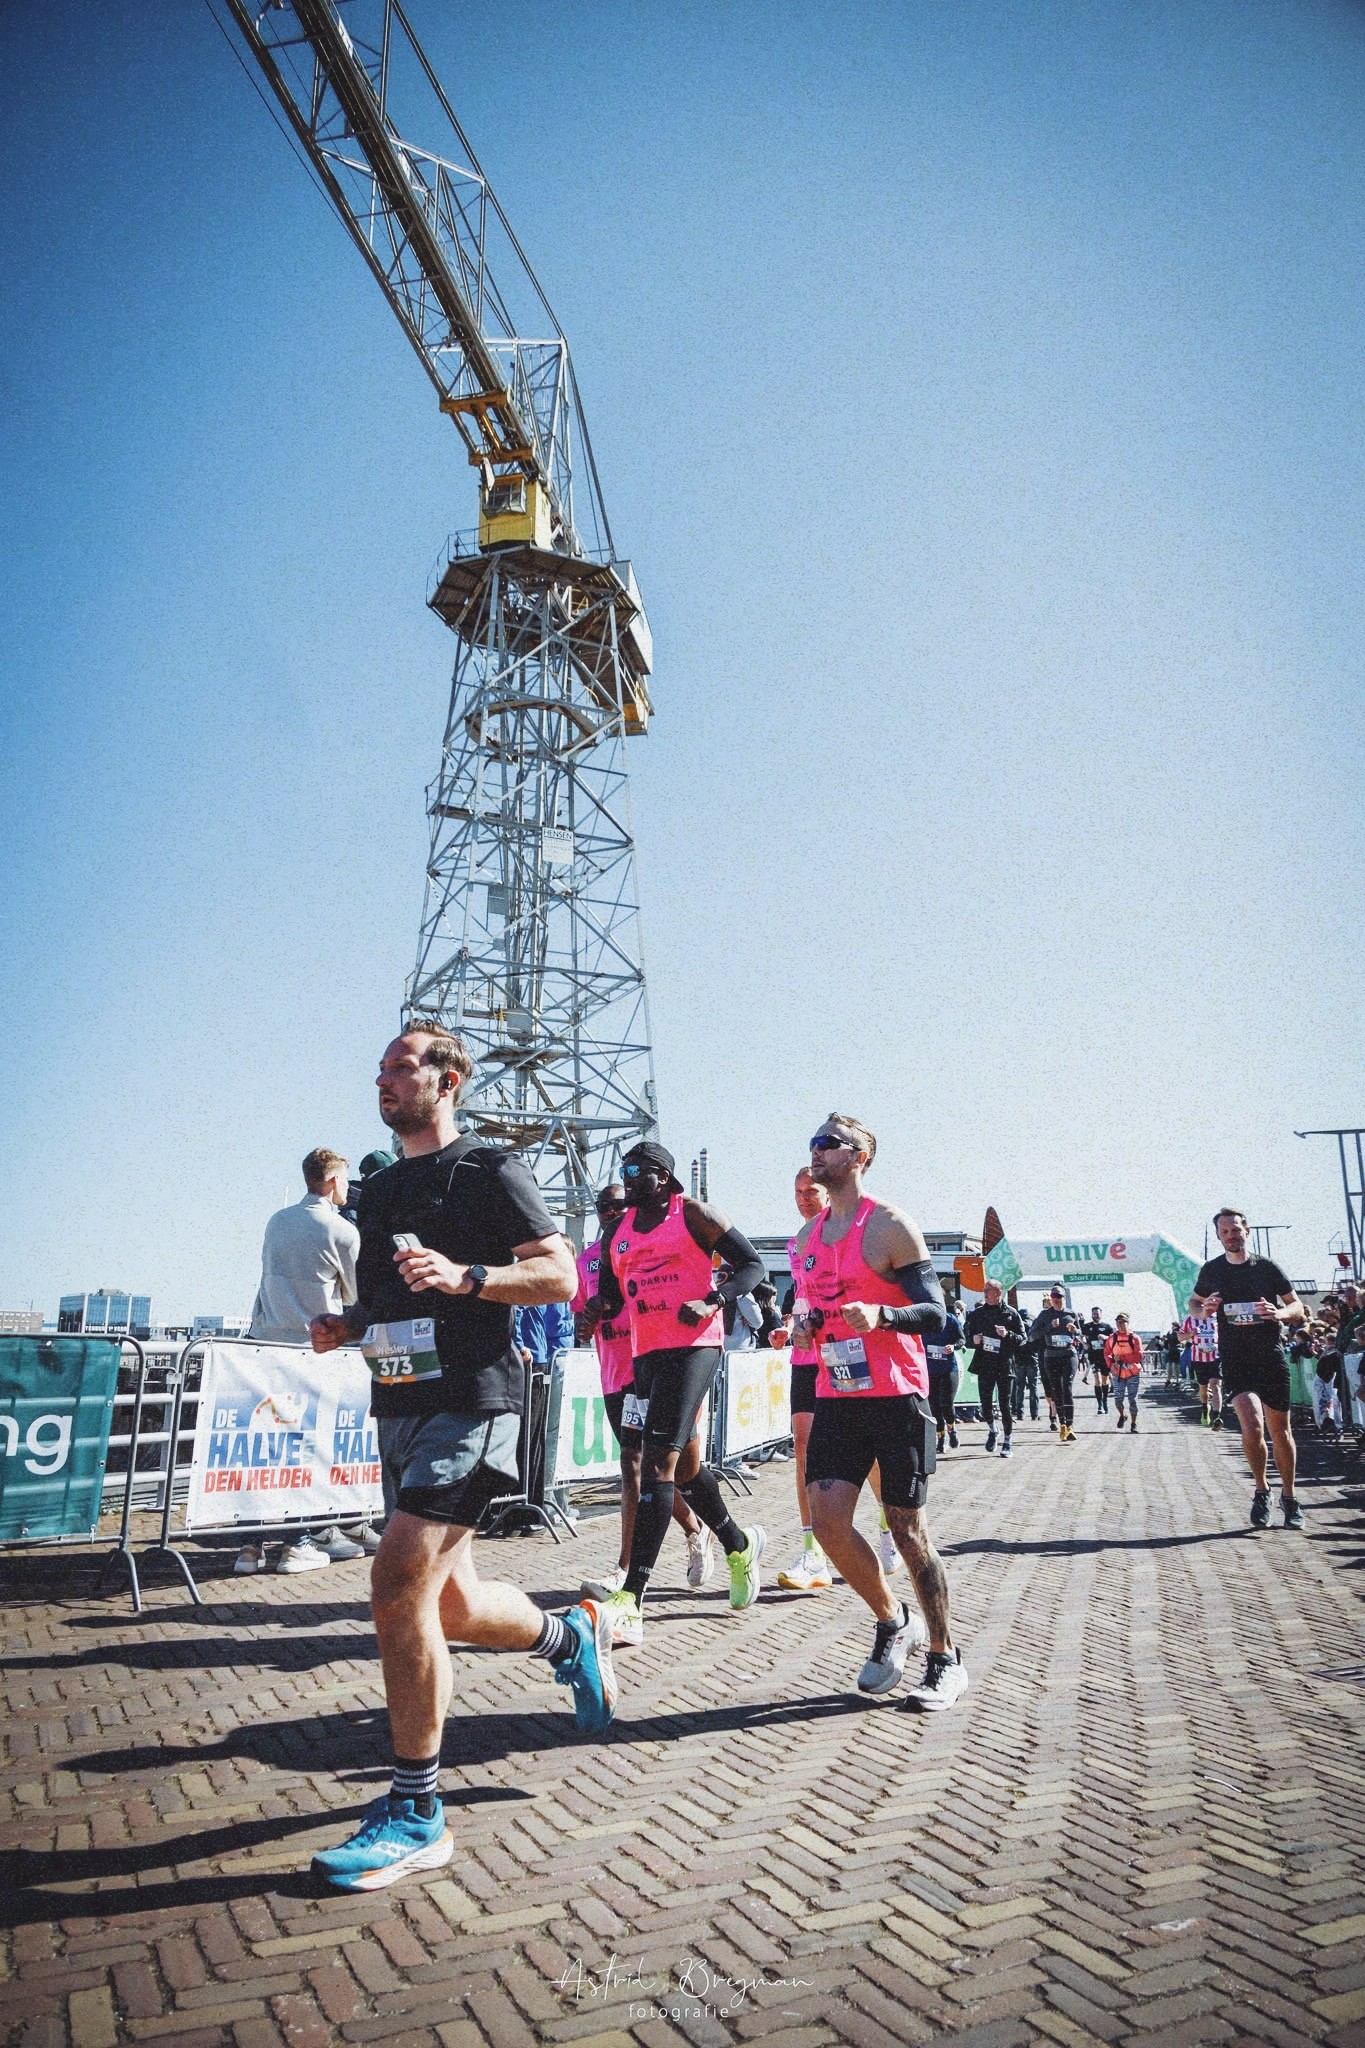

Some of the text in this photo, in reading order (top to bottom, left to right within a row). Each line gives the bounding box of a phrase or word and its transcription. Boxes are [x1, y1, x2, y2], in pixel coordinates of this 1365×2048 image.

[1044, 1238, 1127, 1262] univé
[641, 1274, 679, 1286] DARVIS
[378, 1355, 413, 1376] 373
[833, 1366, 852, 1379] 921
[216, 1408, 238, 1428] DE
[338, 1410, 356, 1427] DE
[572, 1397, 621, 1466] u
[207, 1432, 304, 1468] HALVE
[205, 1468, 312, 1493] DEN HELDER
[330, 1466, 358, 1485] DEN
